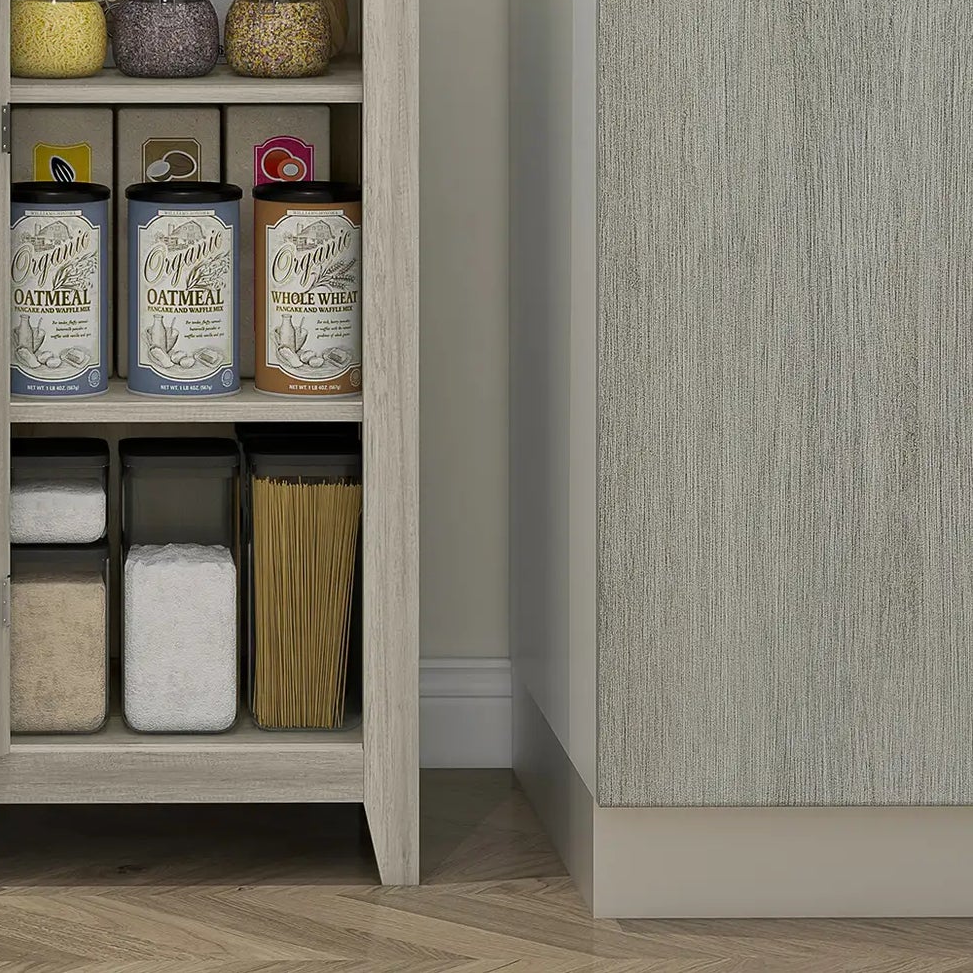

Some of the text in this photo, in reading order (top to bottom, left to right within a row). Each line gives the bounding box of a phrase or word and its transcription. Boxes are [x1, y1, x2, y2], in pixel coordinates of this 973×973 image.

[11, 229, 89, 287] Organic
[143, 229, 222, 287] Organic
[272, 229, 352, 287] Organic
[14, 288, 91, 306] OATMEAL
[147, 288, 224, 306] OATMEAL
[271, 291, 358, 305] WHOLE WHEAT
[15, 306, 41, 314] PANCAKE
[276, 305, 302, 313] PANCAKE
